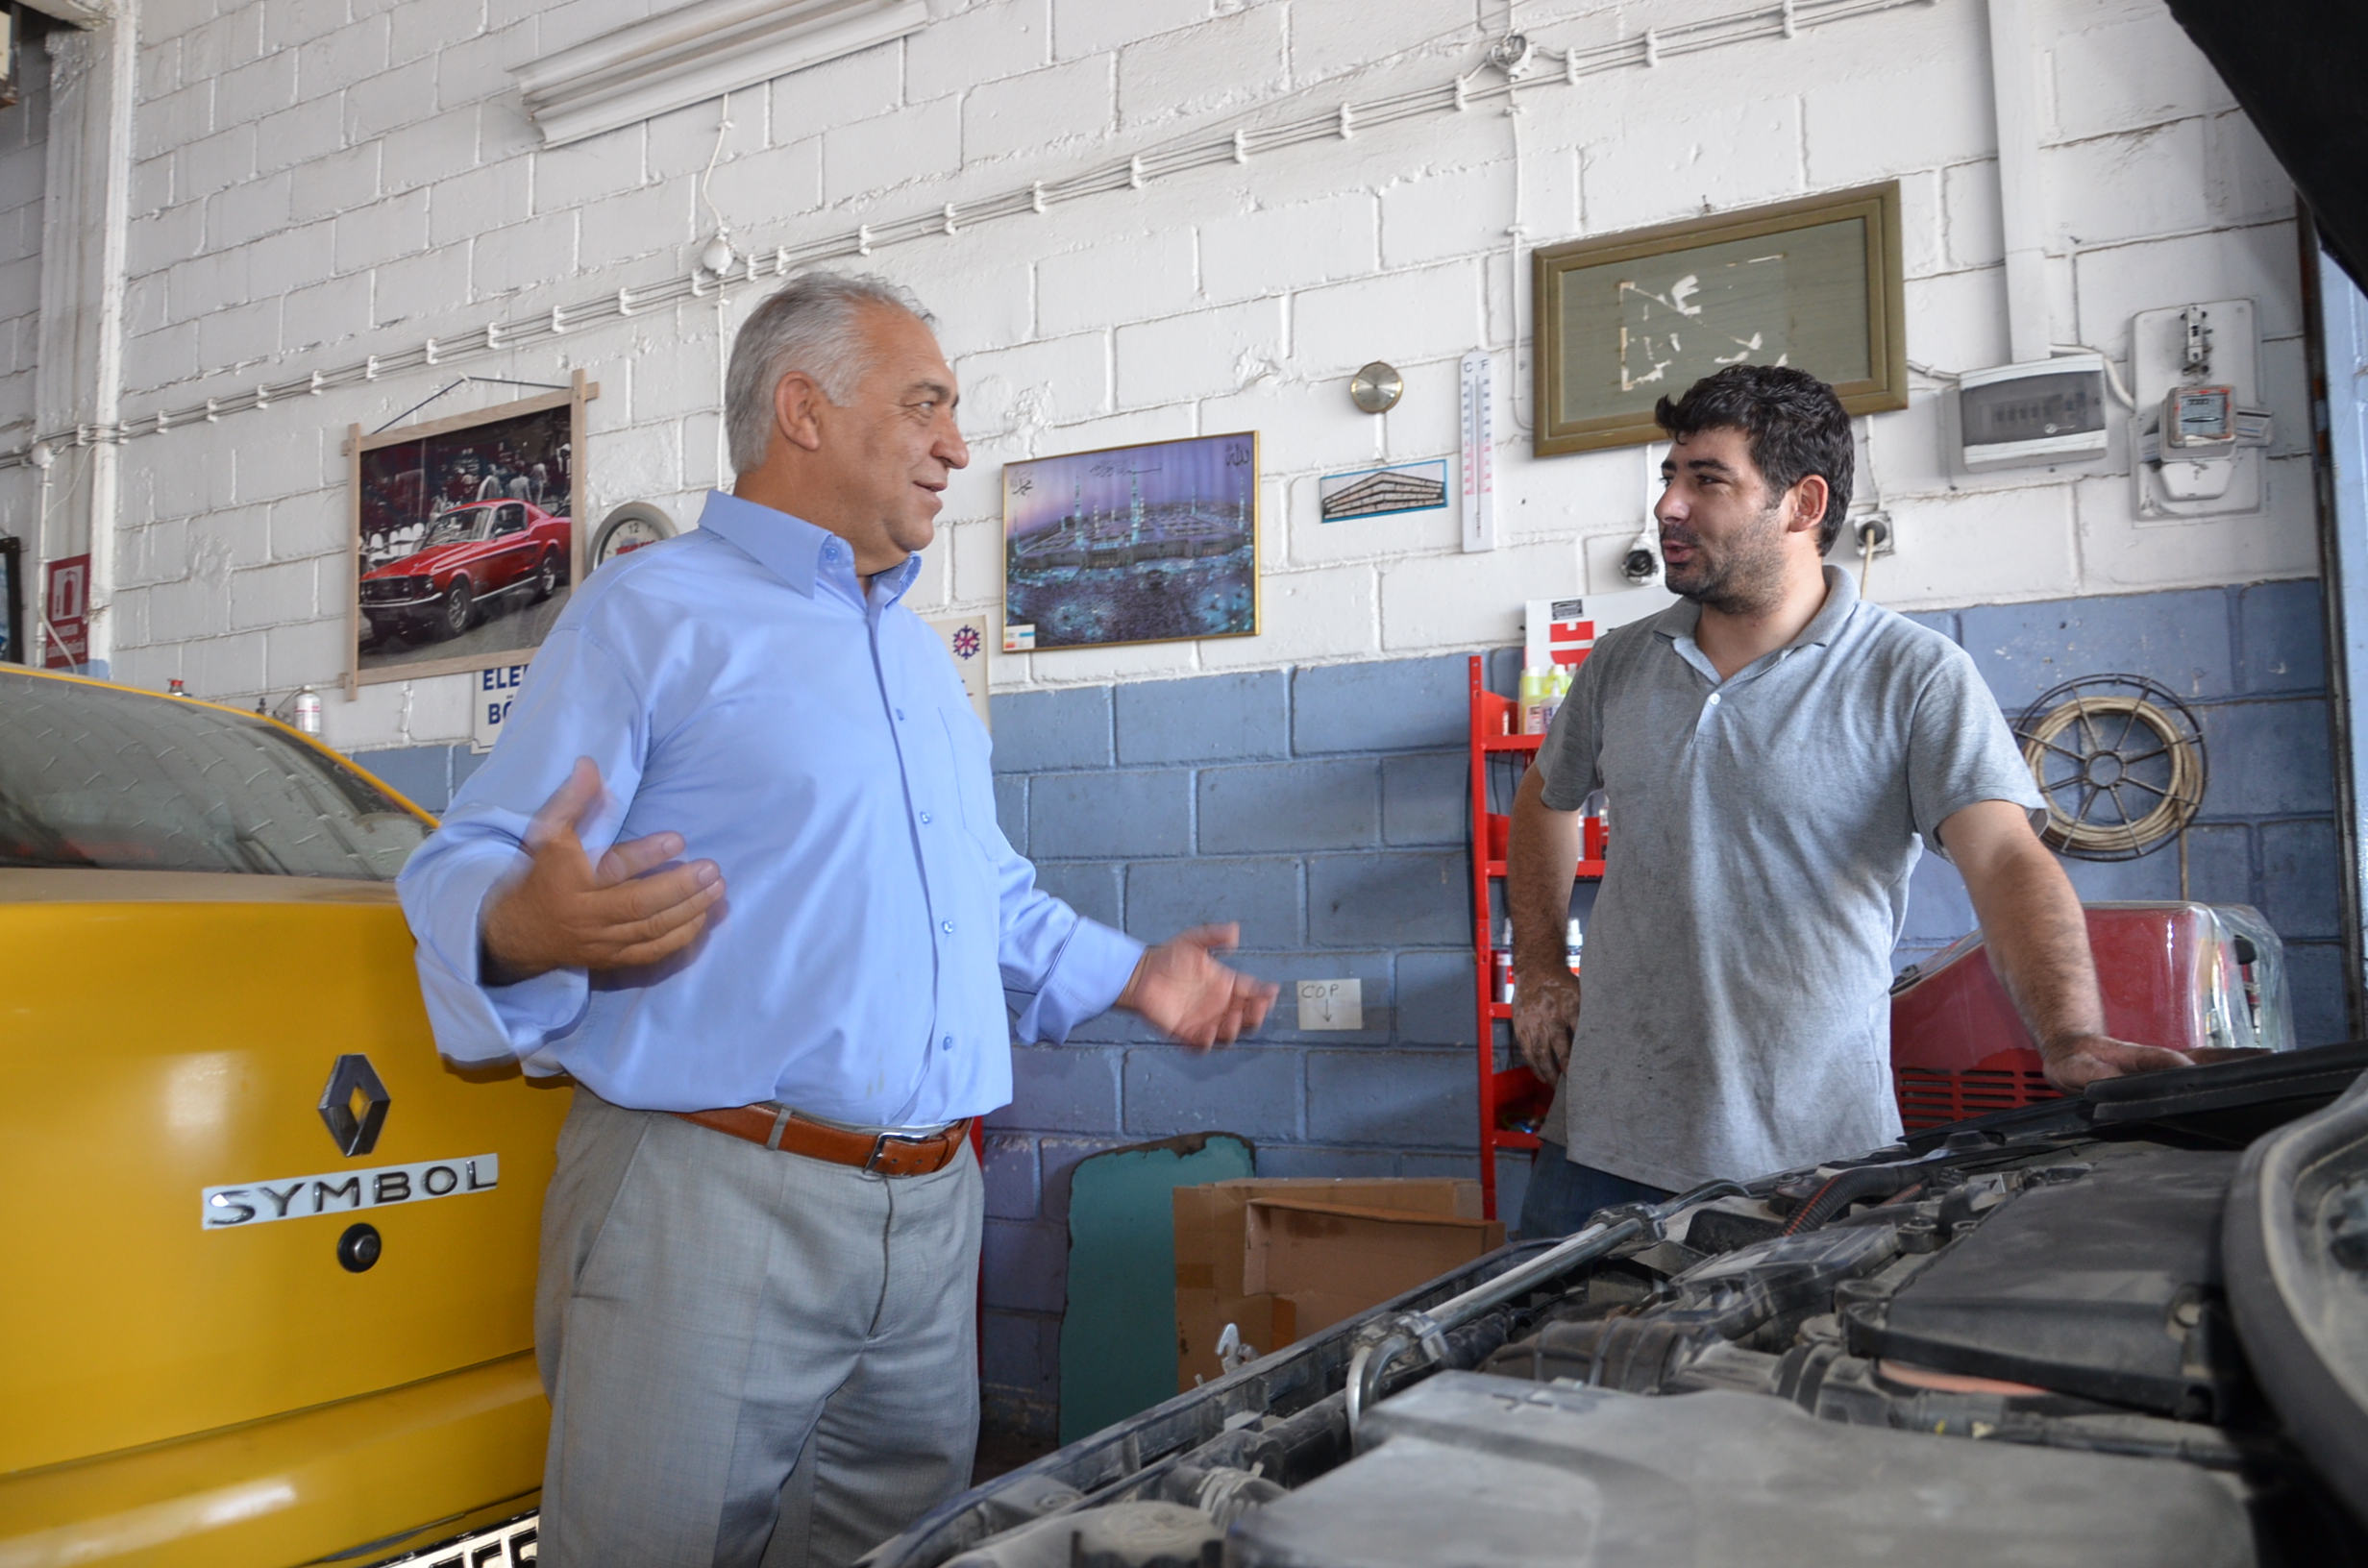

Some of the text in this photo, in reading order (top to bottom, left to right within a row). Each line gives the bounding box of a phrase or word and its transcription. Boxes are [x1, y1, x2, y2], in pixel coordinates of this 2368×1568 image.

[1464, 361, 1473, 373] C
[1481, 358, 1490, 371] F
[629, 522, 639, 534] 12
[482, 664, 530, 691] ELE
[1301, 983, 1339, 999] COP
[208, 1160, 497, 1225] SYMBOL
